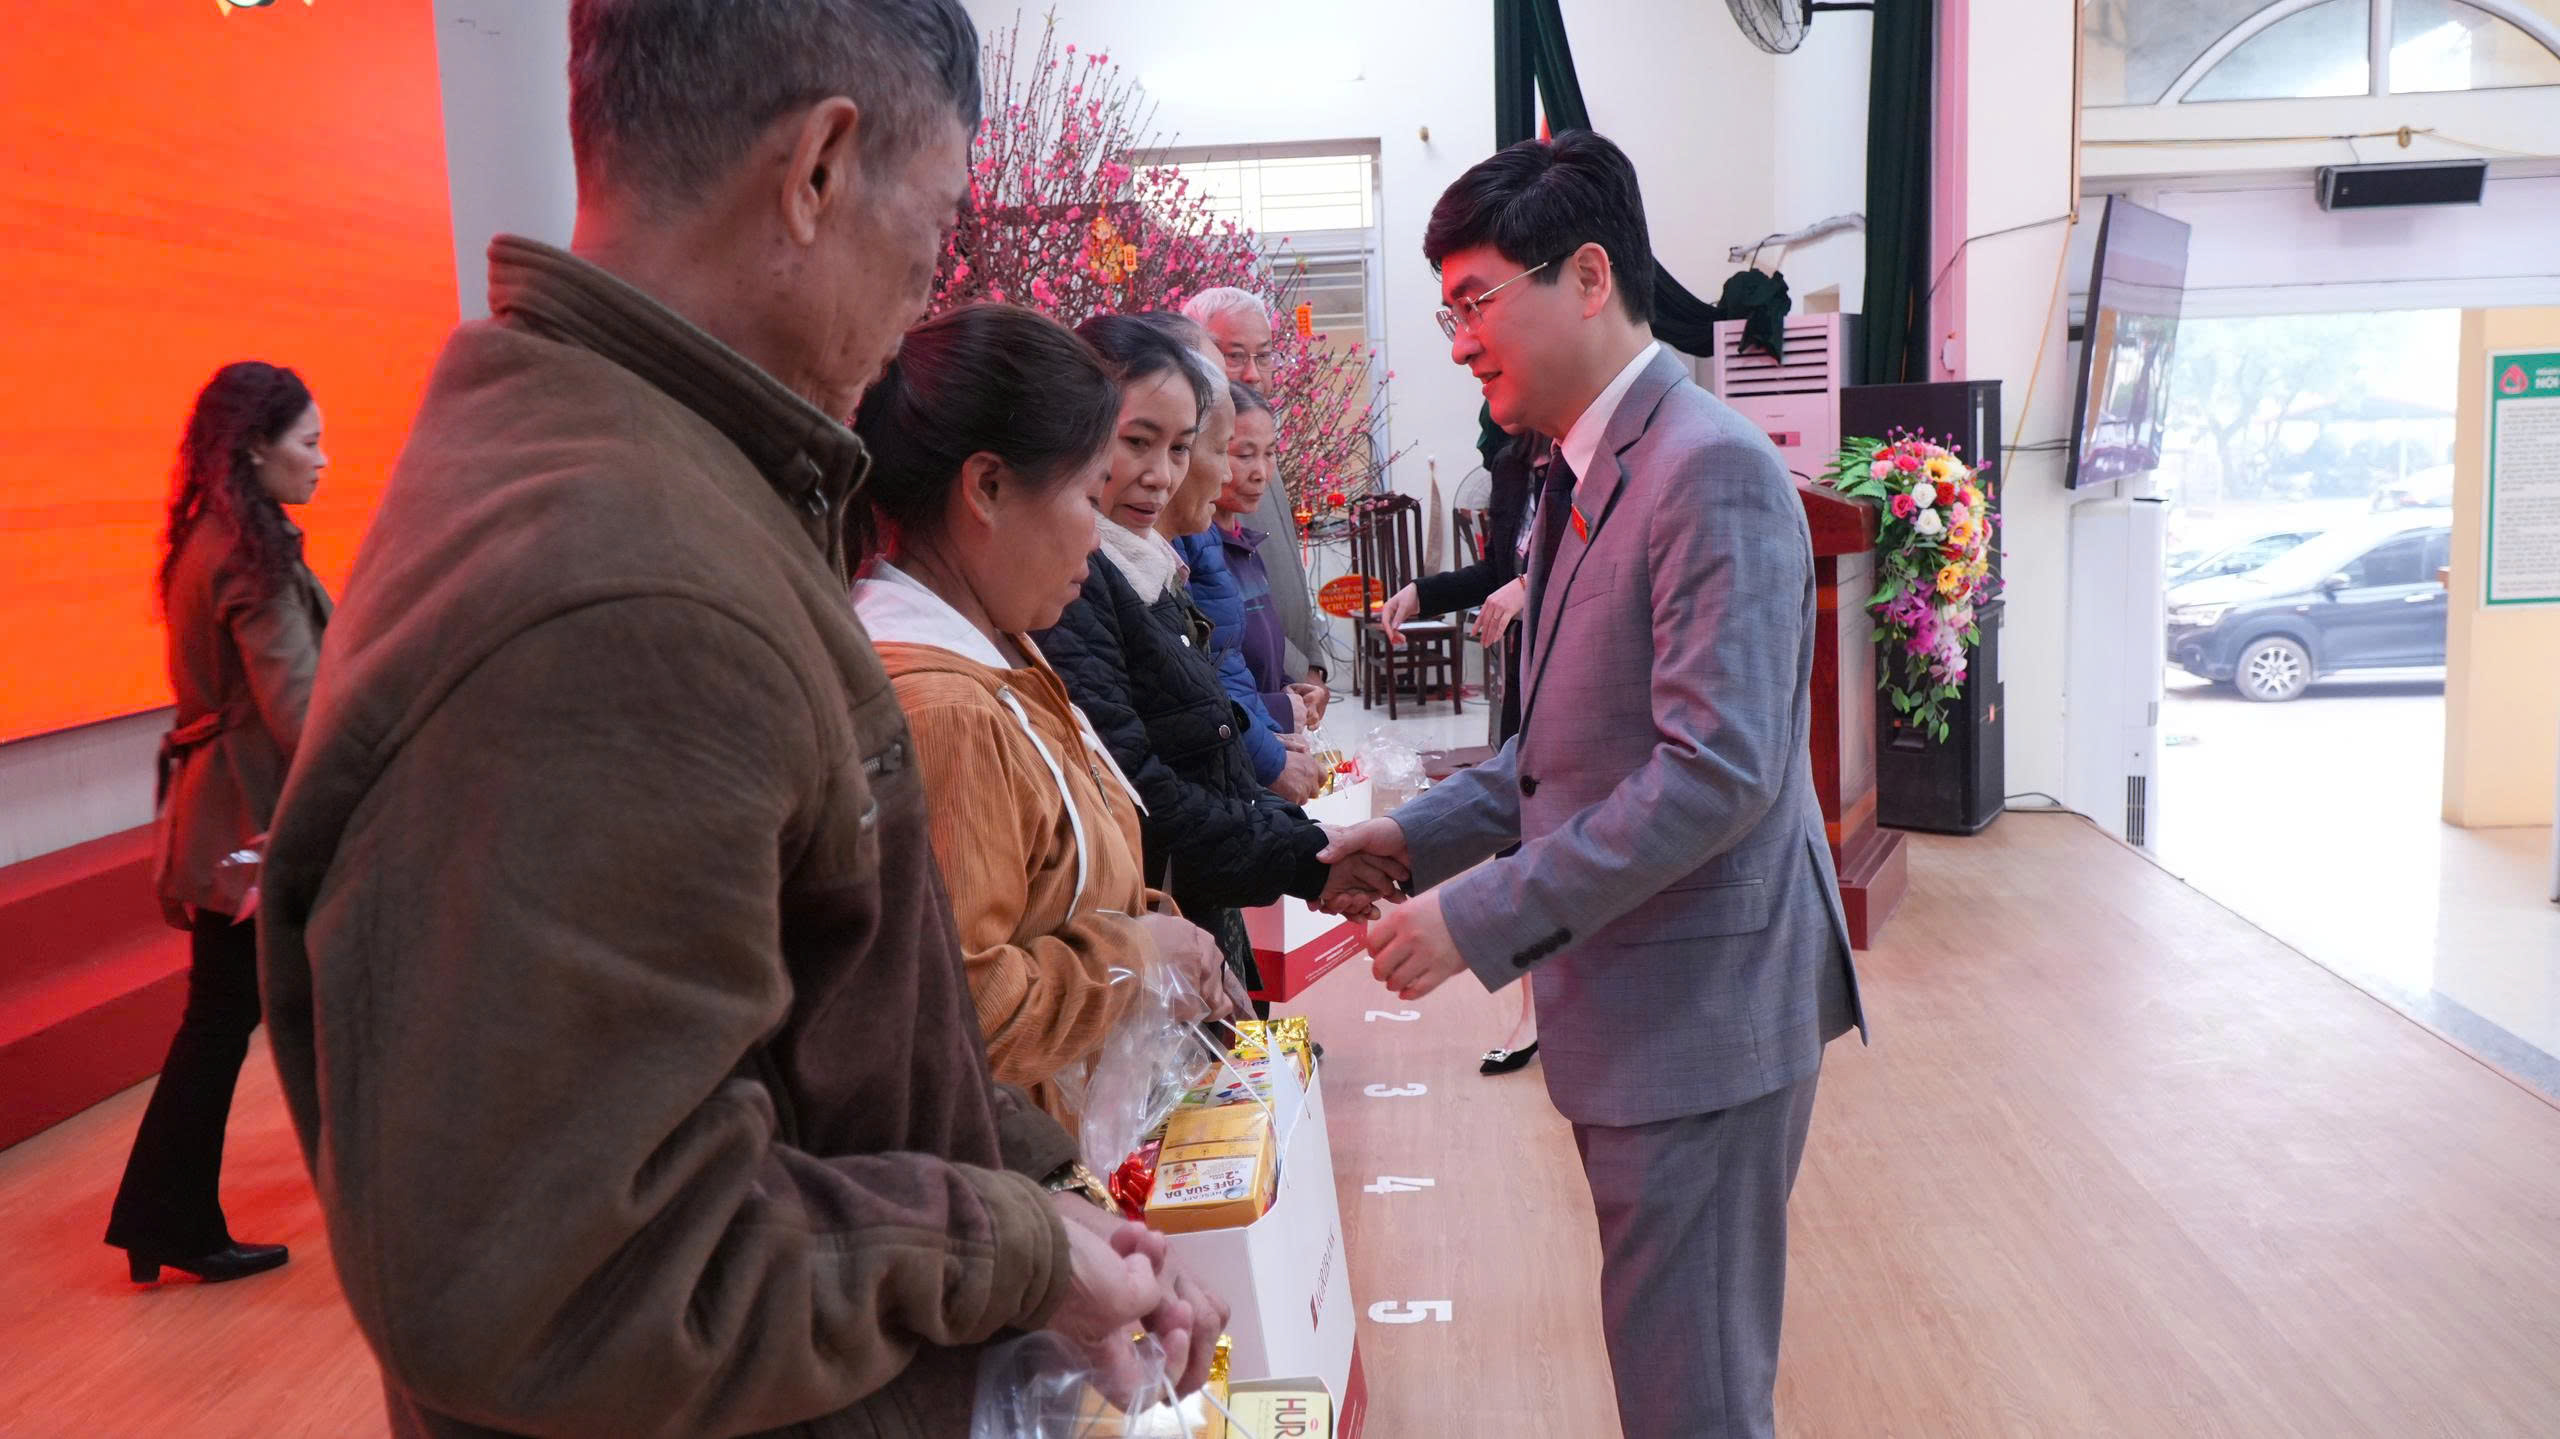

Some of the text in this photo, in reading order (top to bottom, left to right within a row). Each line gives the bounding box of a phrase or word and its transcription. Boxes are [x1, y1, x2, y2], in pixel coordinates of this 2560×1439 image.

[1364, 1010, 1421, 1022] 2
[1363, 1082, 1428, 1098] 3
[1363, 1176, 1436, 1195] 4
[1367, 1300, 1453, 1324] 5
[1274, 1398, 1307, 1439] HUR
